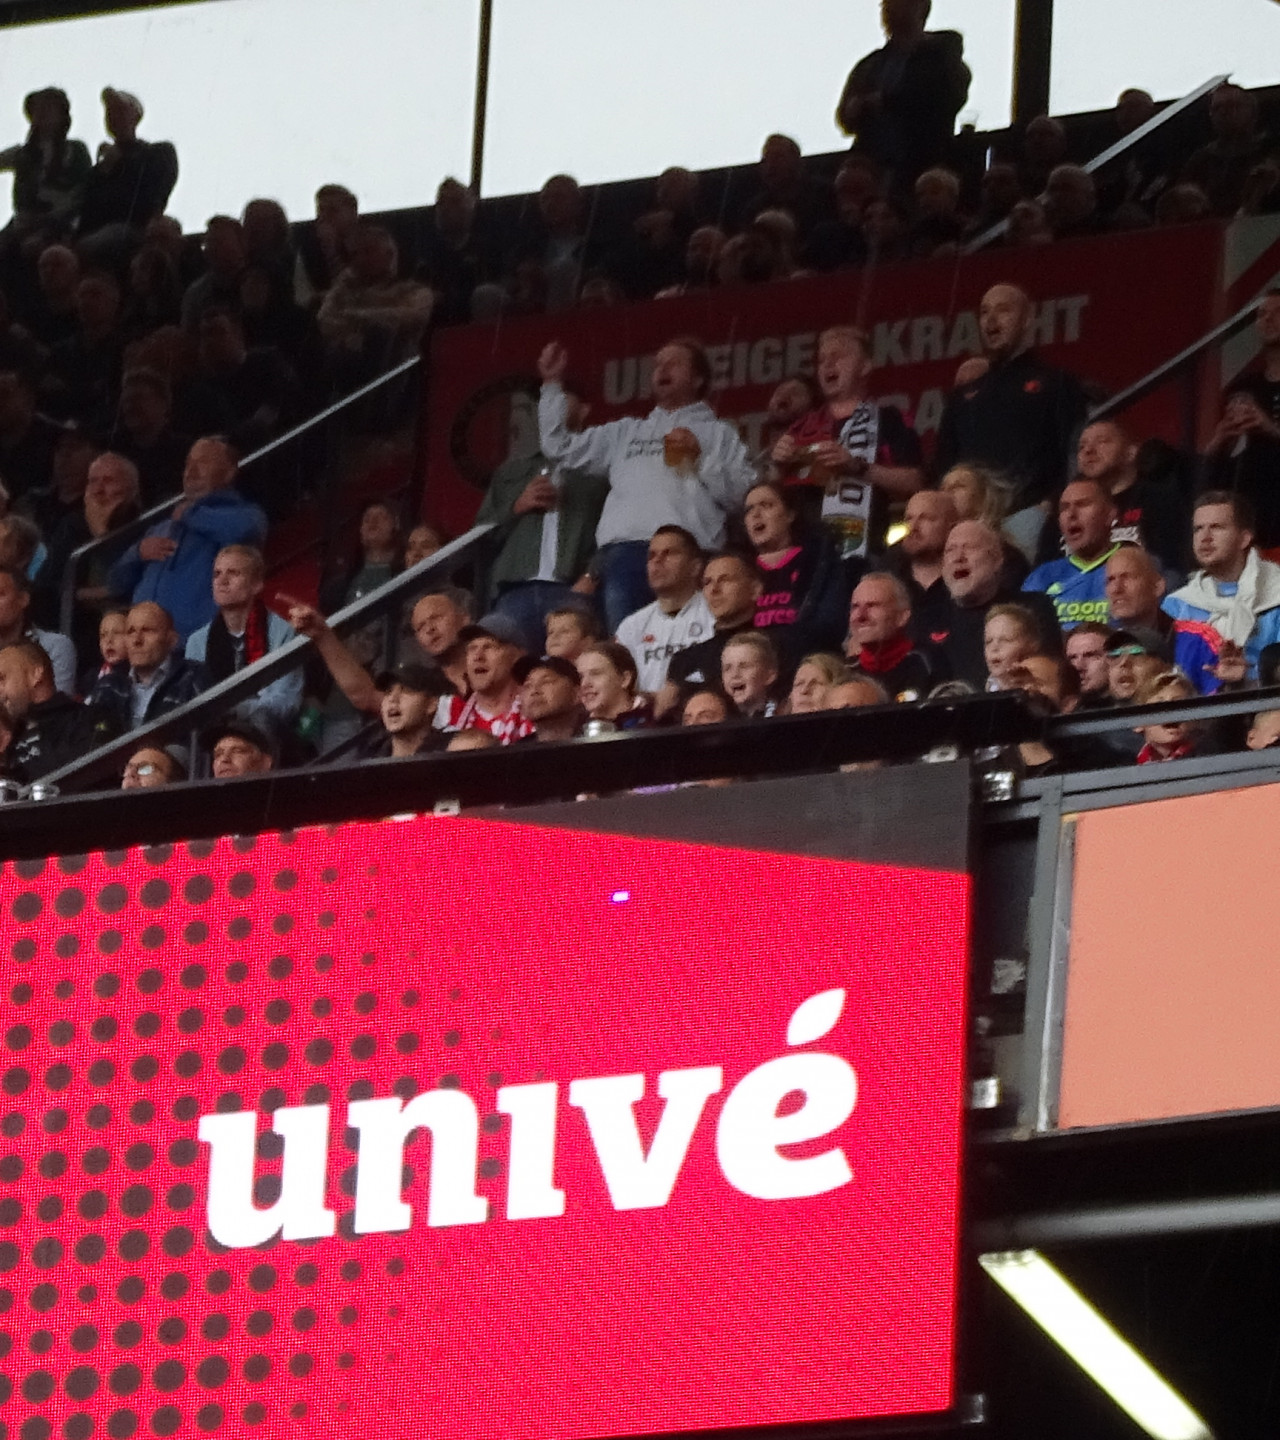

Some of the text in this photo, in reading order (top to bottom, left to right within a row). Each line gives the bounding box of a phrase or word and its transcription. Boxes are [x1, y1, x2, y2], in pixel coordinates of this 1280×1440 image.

[710, 334, 817, 388] EIGE
[873, 294, 1090, 368] KRAHT
[197, 987, 859, 1249] univé
